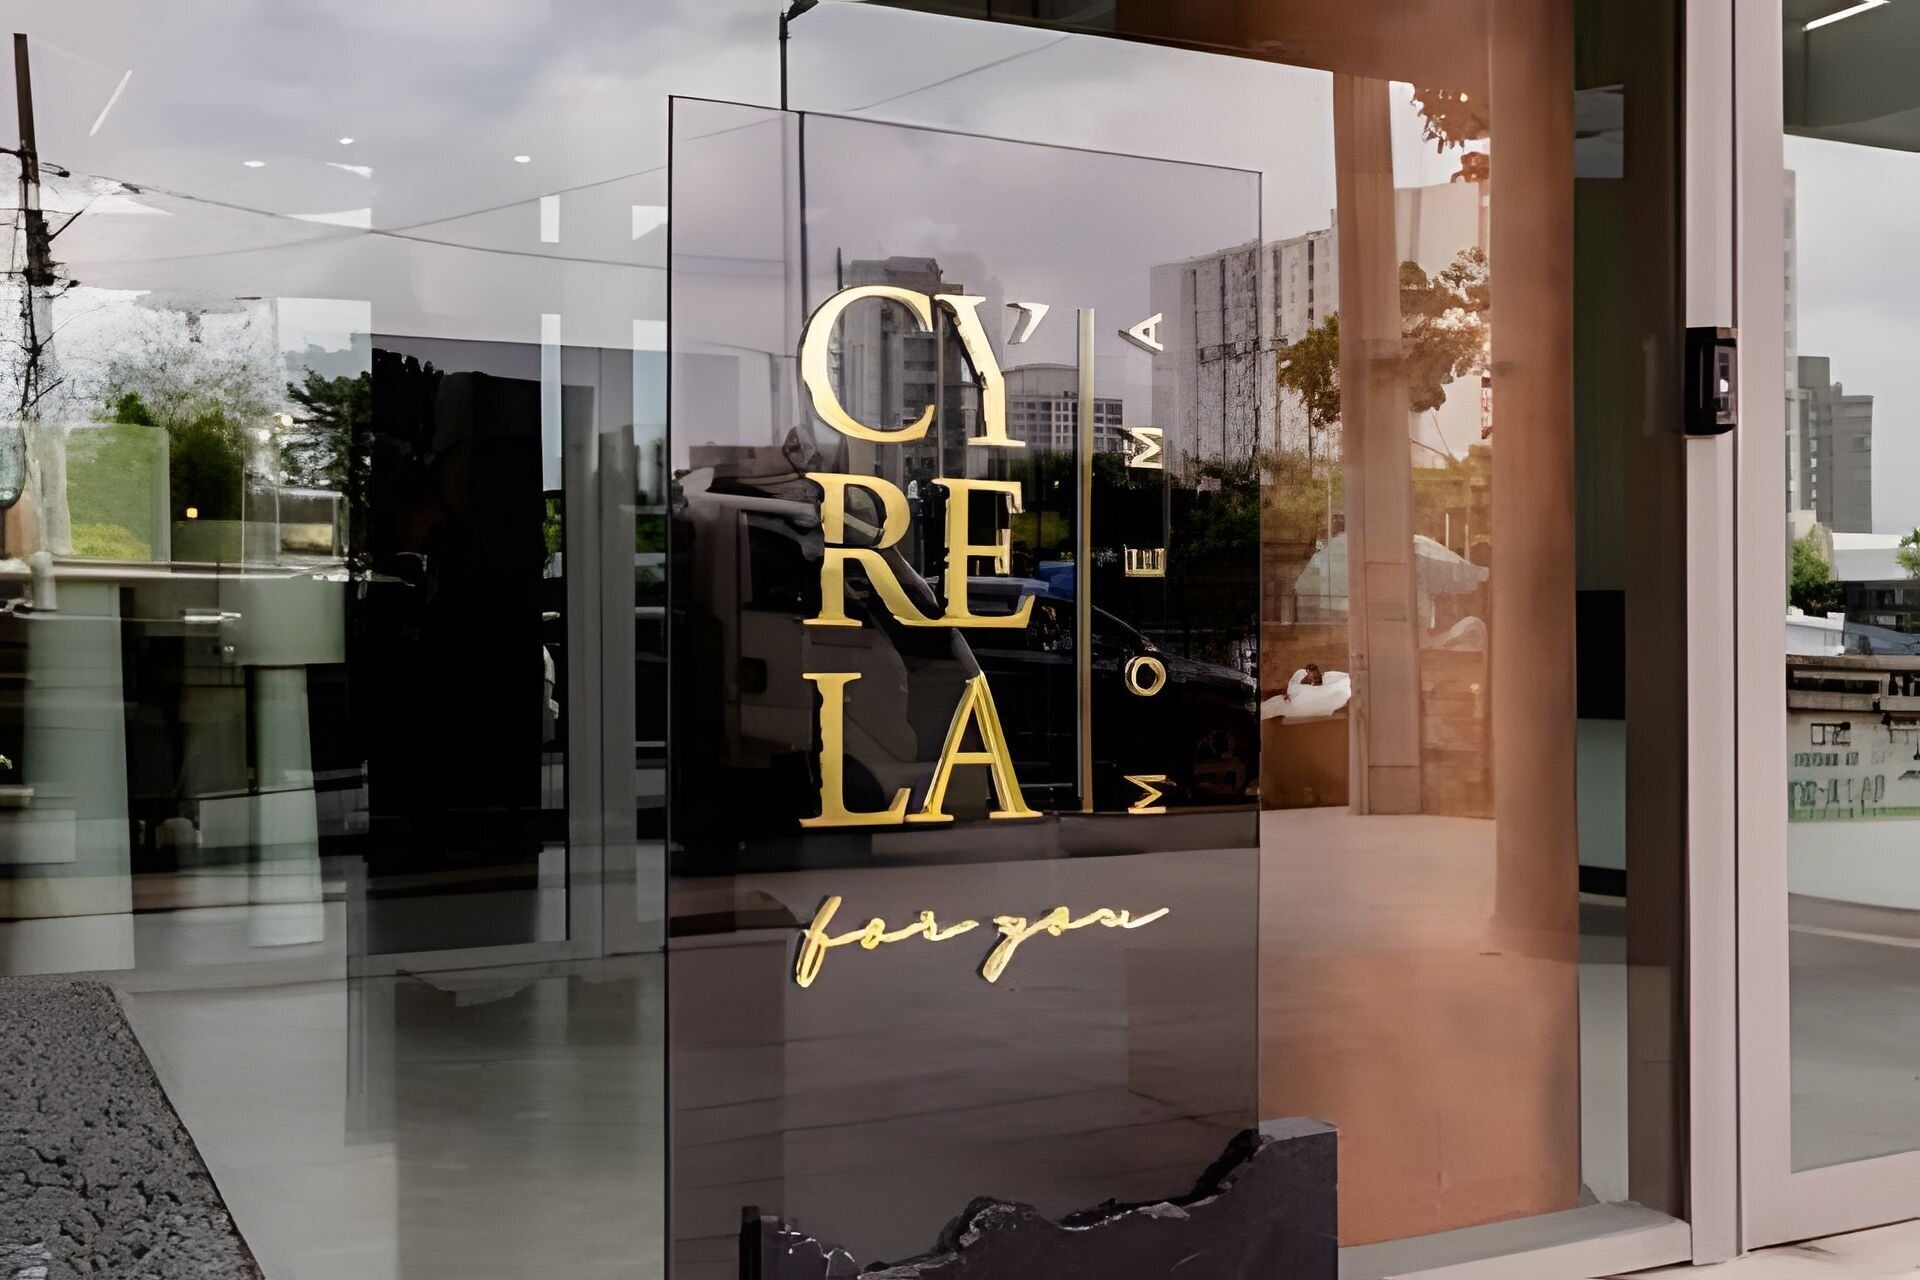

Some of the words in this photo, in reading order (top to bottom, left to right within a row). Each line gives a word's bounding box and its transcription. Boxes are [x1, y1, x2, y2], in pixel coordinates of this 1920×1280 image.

[1120, 312, 1168, 814] MOEMA
[796, 896, 979, 988] for
[982, 906, 1170, 983] you
